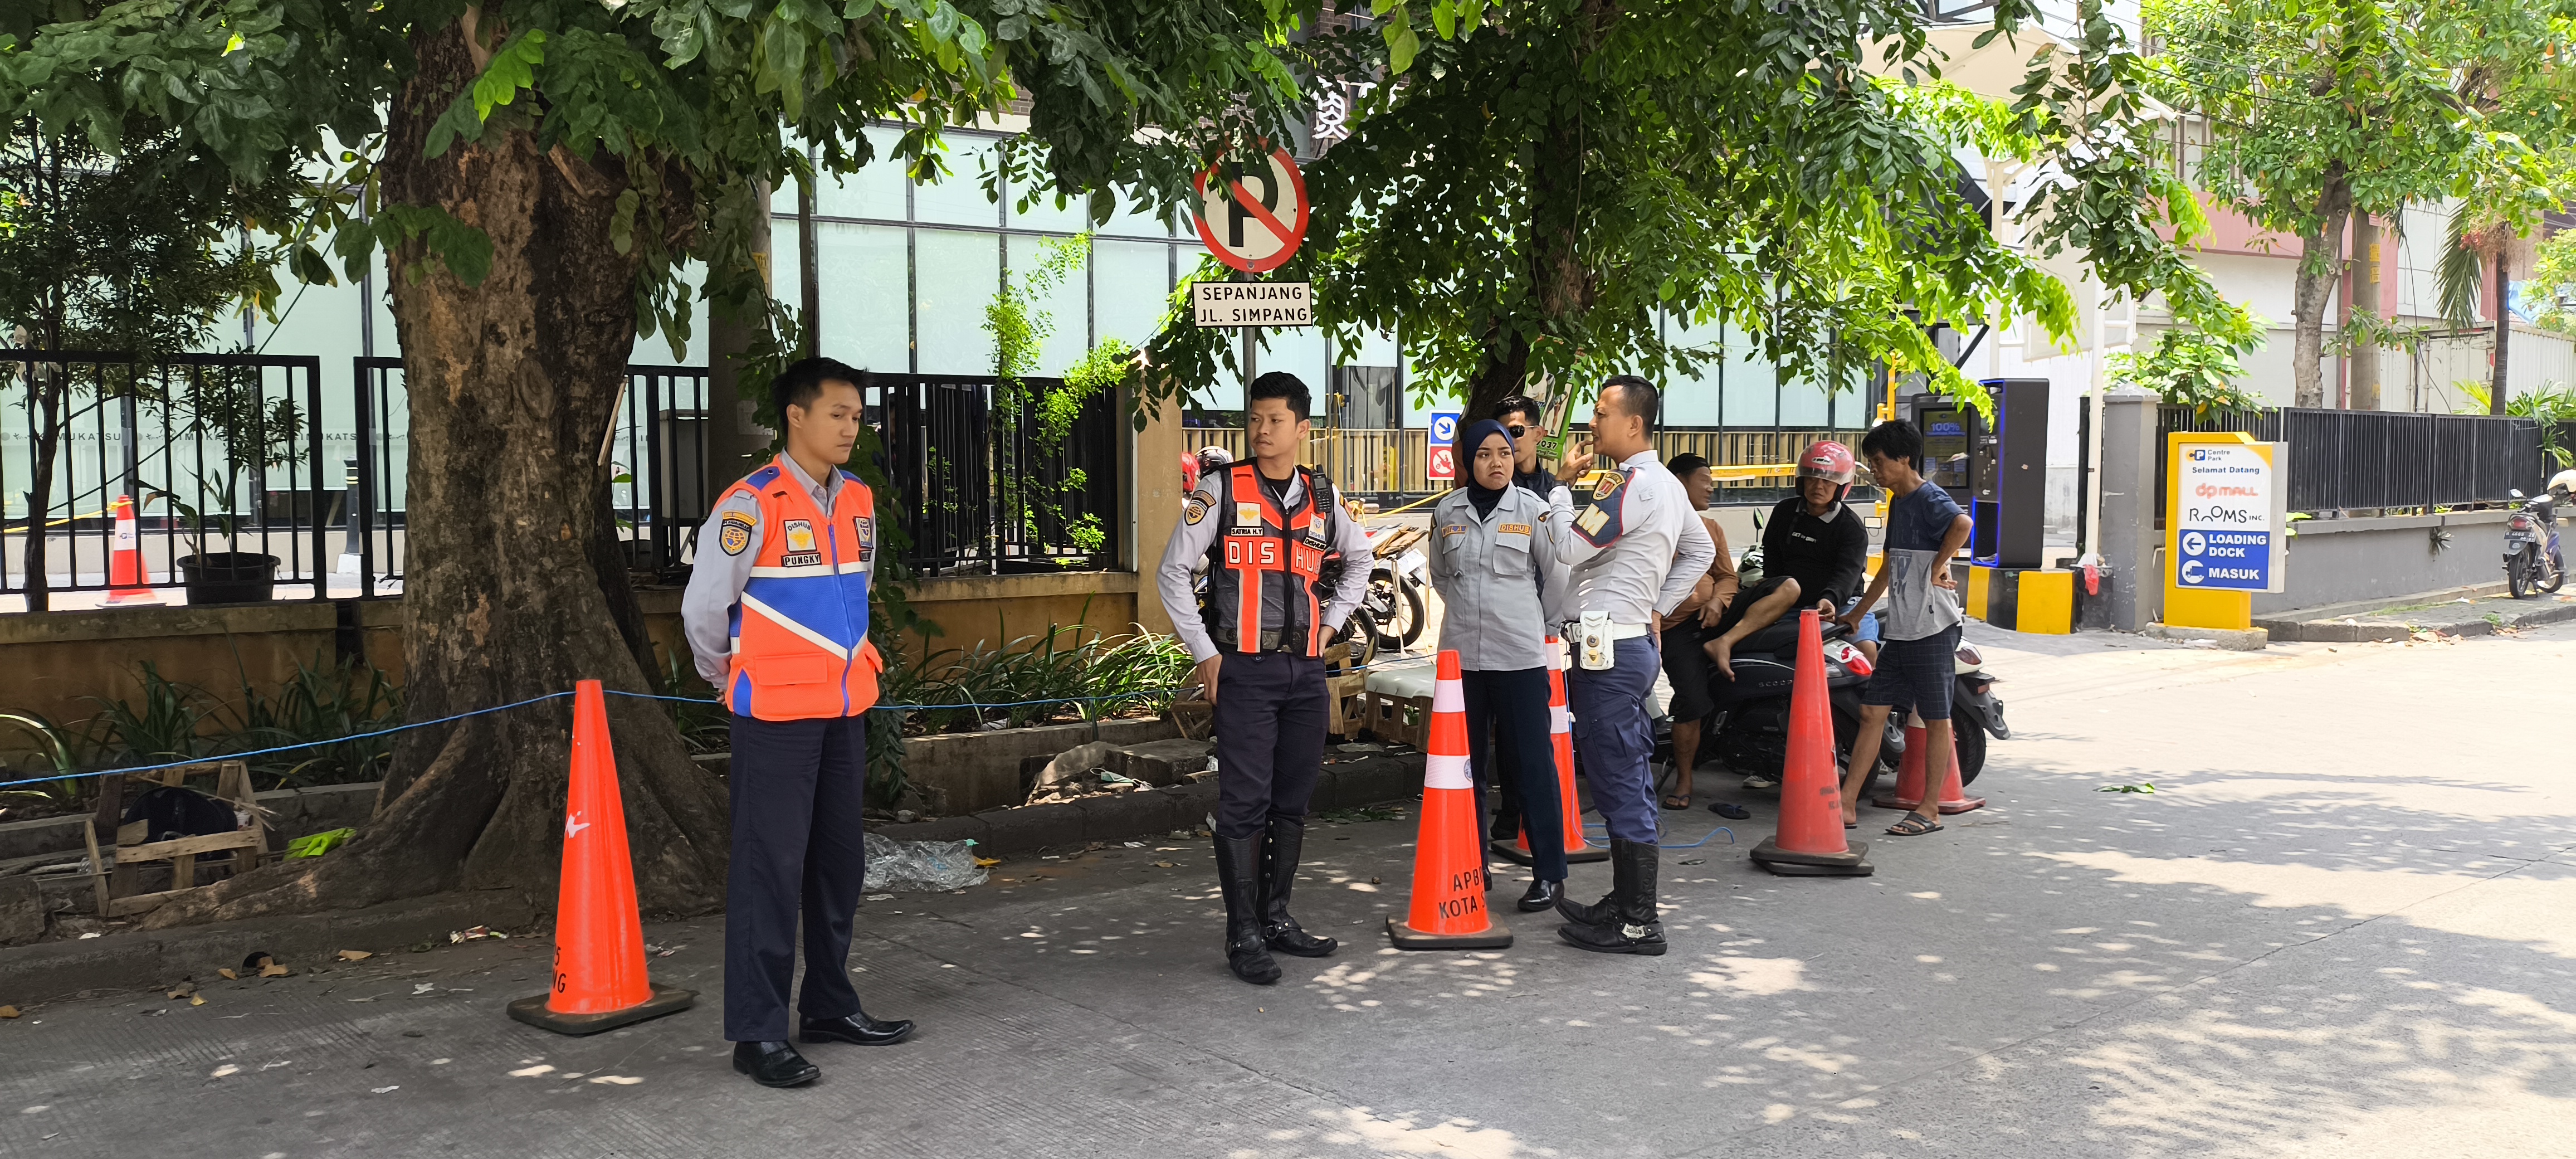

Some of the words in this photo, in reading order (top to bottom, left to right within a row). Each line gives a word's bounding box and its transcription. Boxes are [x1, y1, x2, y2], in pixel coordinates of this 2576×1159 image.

[1203, 286, 1302, 300] SEPANJANG
[1200, 309, 1223, 322] JL.
[1232, 308, 1307, 322] SIMPANG
[1931, 422, 1960, 431] 100%
[1536, 440, 1557, 449] 037
[2229, 466, 2260, 475] Datang
[1576, 503, 1610, 537] M
[787, 522, 811, 531] DISHUB
[1501, 524, 1529, 533] DISHUB
[2209, 534, 2266, 545] LOADING
[1228, 540, 1275, 564] DIS
[1295, 545, 1318, 574] HU
[2209, 547, 2245, 557] DOCK
[784, 554, 819, 565] PUNGKY
[2208, 567, 2260, 580] MASUK
[1758, 679, 1793, 688] SCOOP
[1438, 895, 1478, 919] KOTA
[553, 944, 561, 966] 5
